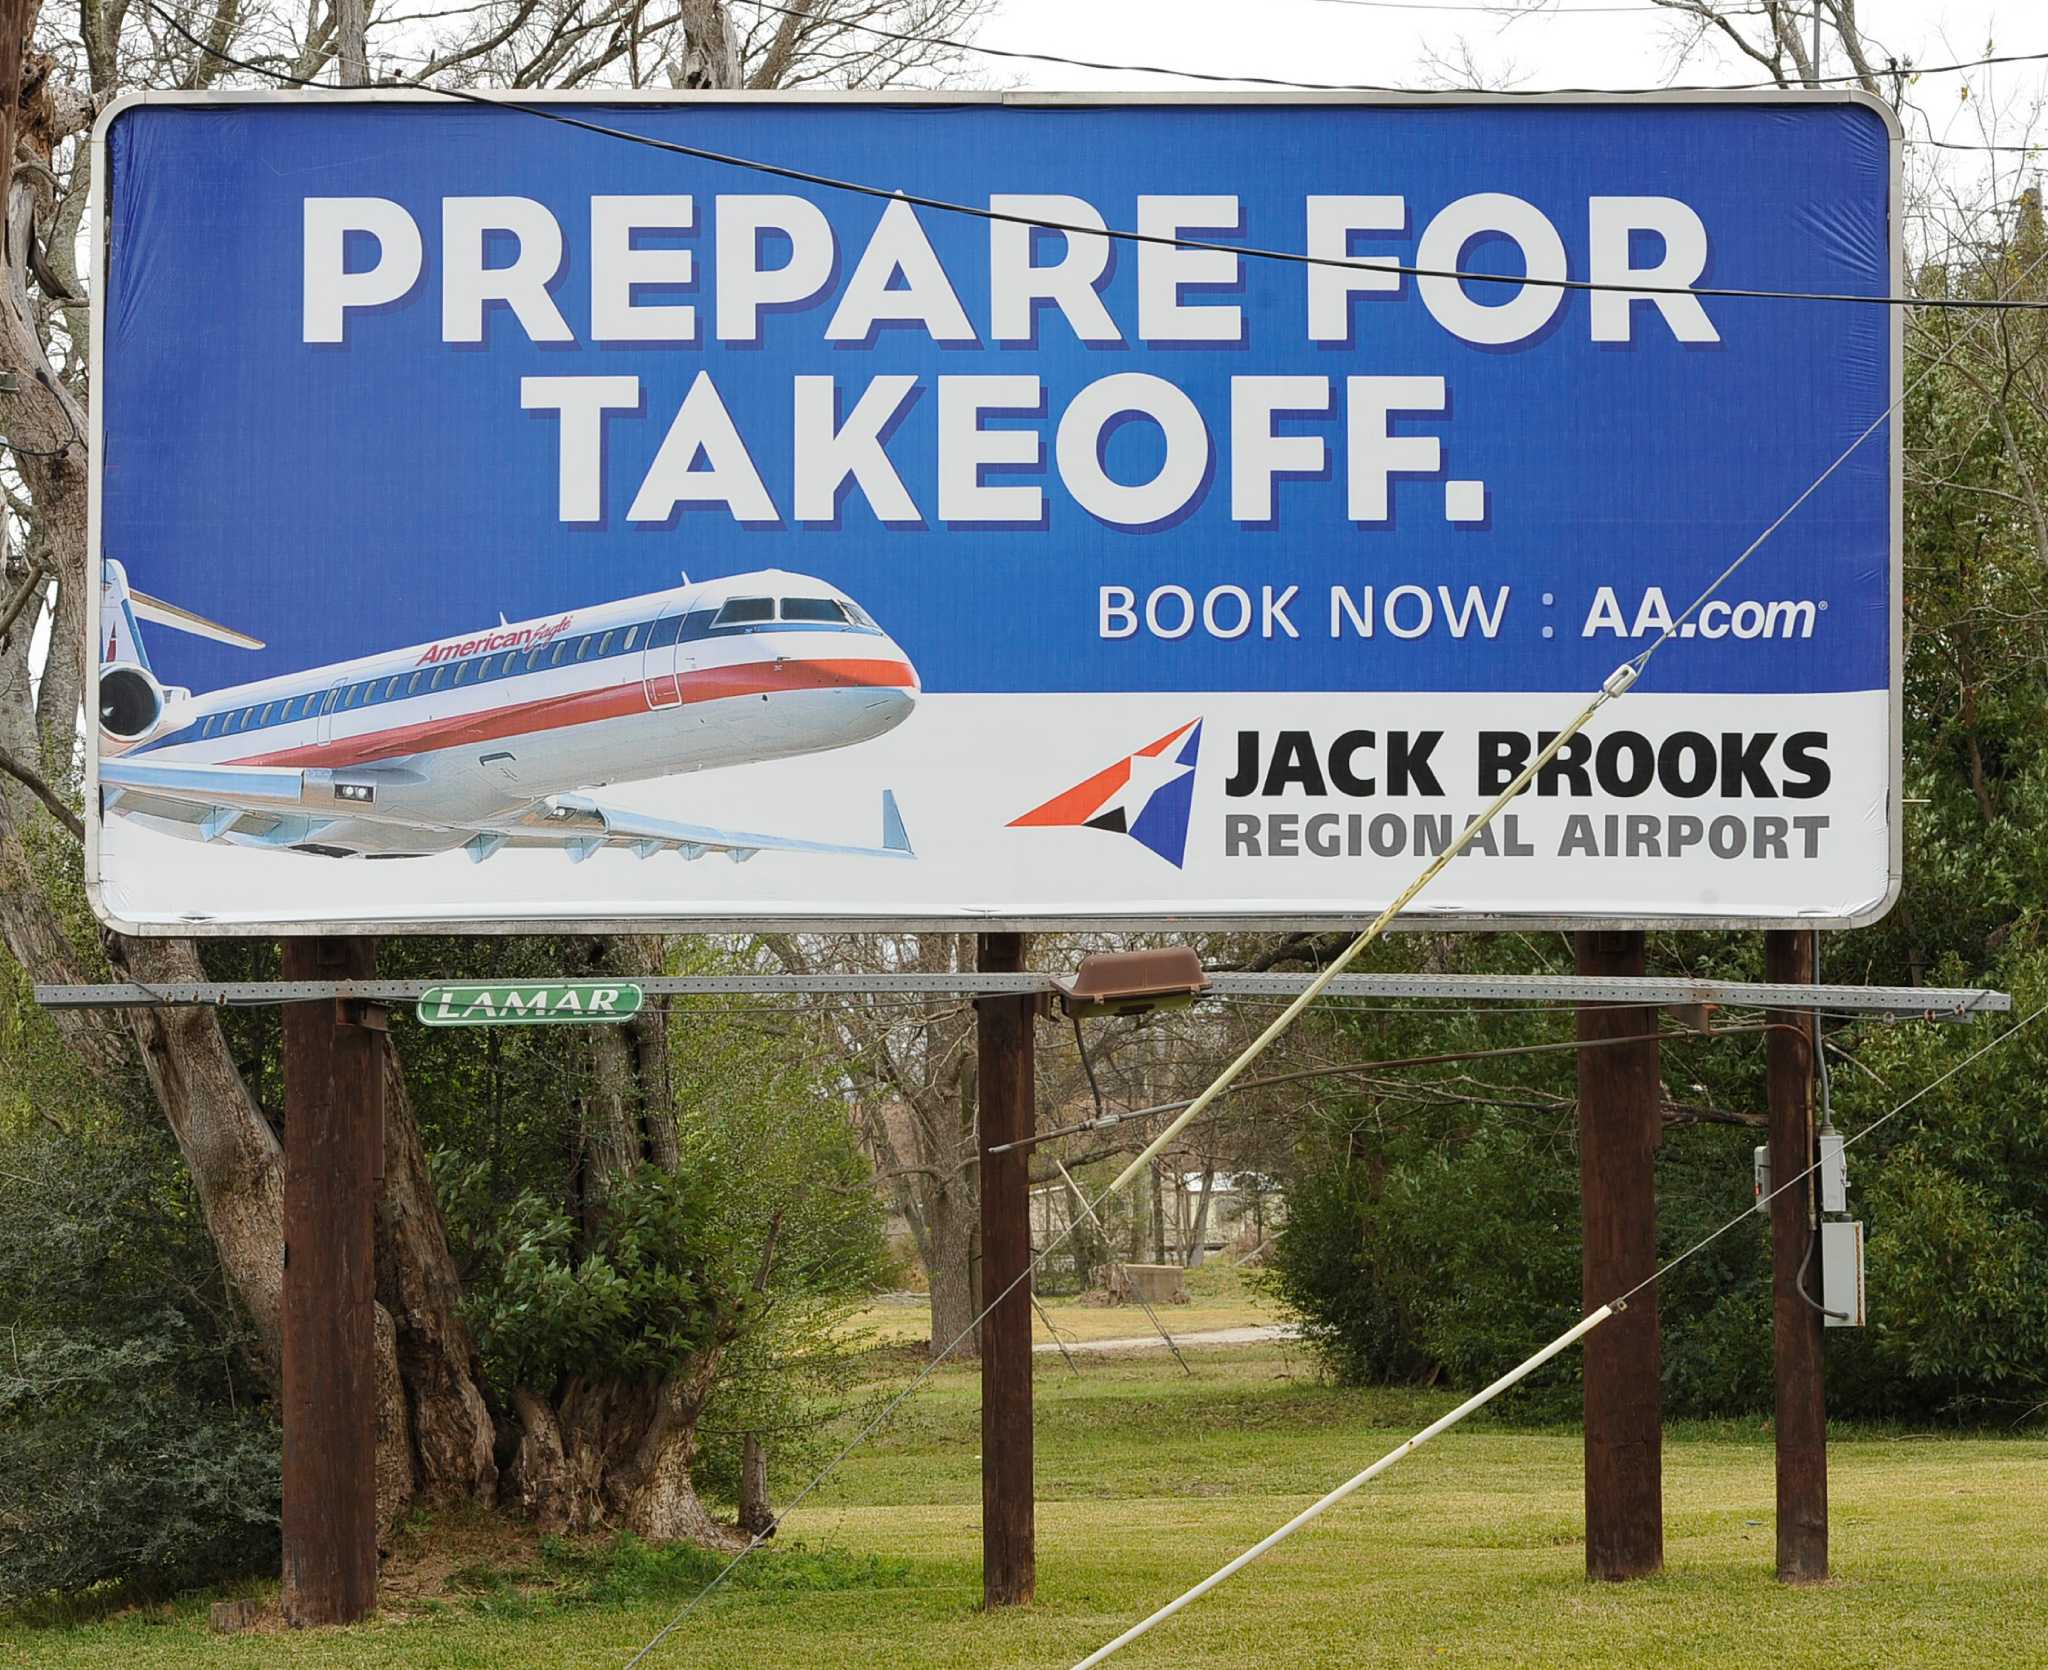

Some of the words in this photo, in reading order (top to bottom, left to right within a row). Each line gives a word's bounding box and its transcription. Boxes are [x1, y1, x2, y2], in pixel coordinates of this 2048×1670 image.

[302, 190, 1242, 343] PREPARE
[1306, 192, 1722, 345] FOR
[520, 370, 1487, 526] TAKEOFF.
[1098, 584, 1299, 639] BOOK
[1330, 584, 1510, 639] NOW
[416, 627, 531, 666] American
[1225, 729, 1446, 798] JACK
[1478, 730, 1831, 799] BROOKS
[1225, 812, 1535, 858] REGIONAL
[1557, 813, 1831, 860] AIRPORT
[436, 988, 620, 1018] LAMAR
